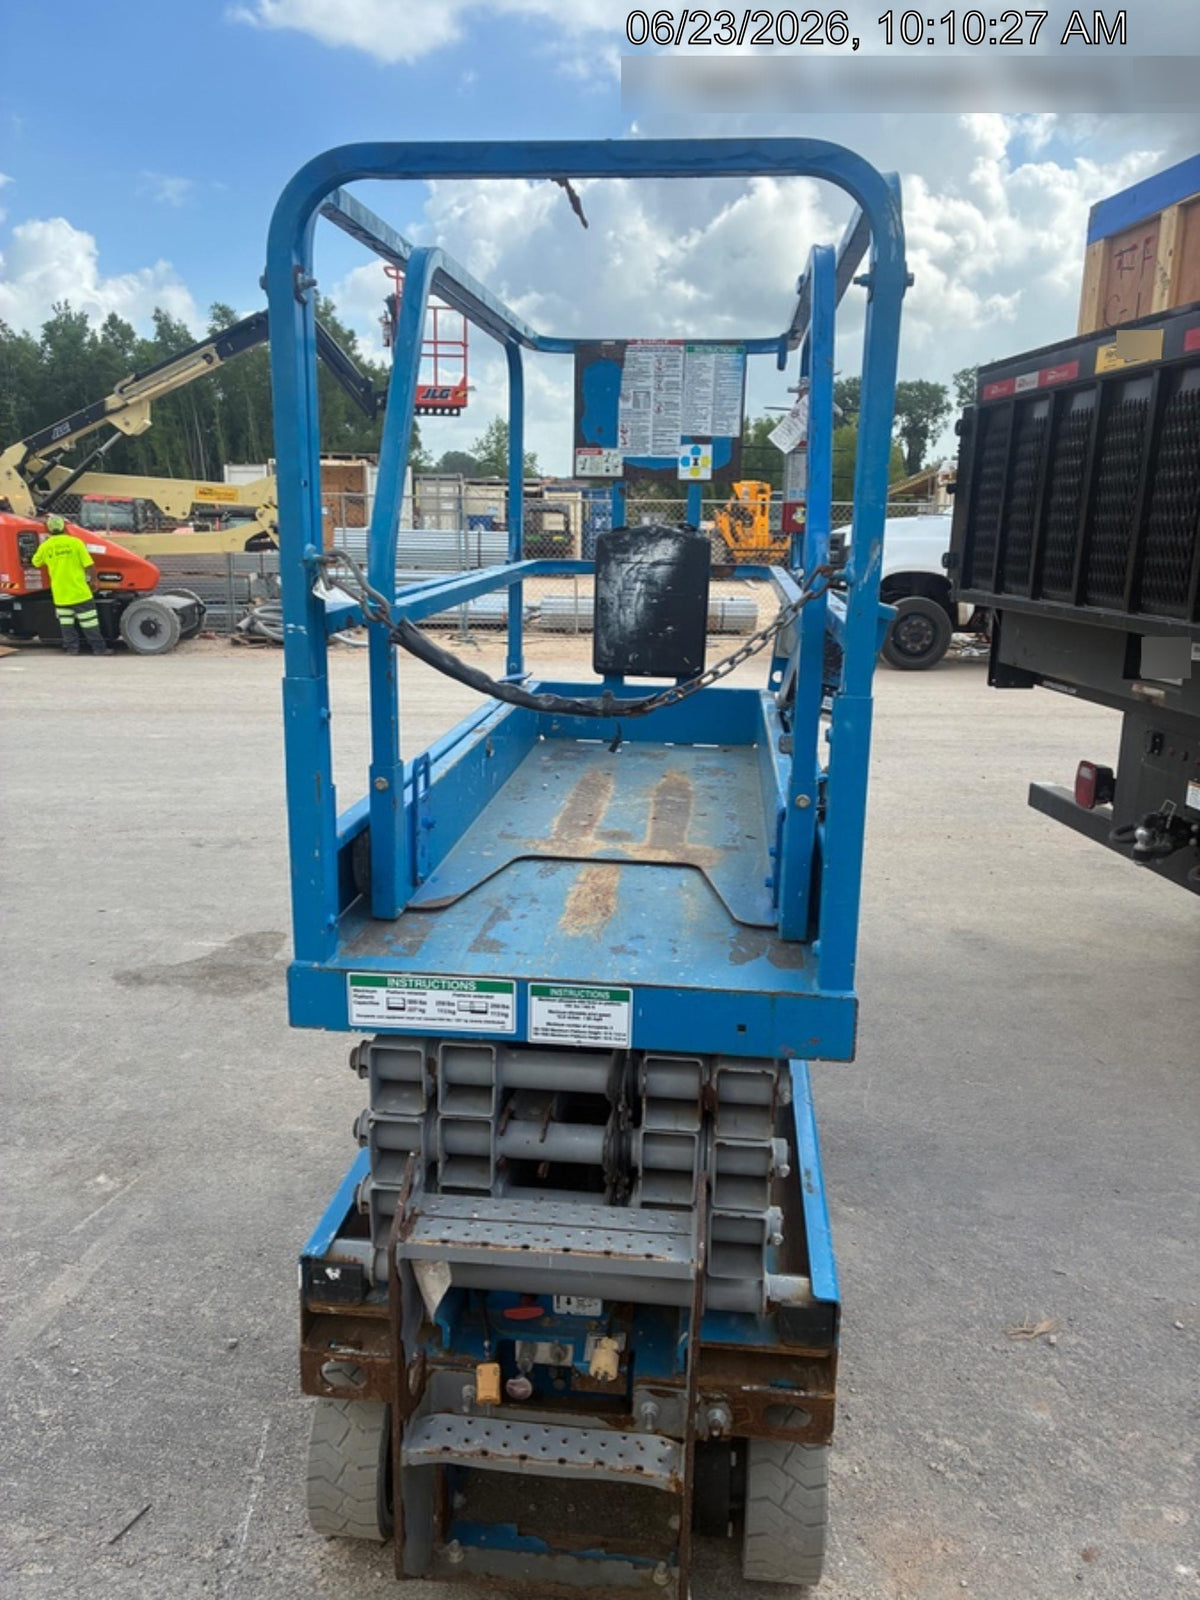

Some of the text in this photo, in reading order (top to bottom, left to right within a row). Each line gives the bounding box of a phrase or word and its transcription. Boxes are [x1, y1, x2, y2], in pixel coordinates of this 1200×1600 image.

[421, 388, 452, 399] JLG
[387, 977, 477, 991] INSTRUCTIONS
[549, 987, 611, 999] INSTRUCTIONS
